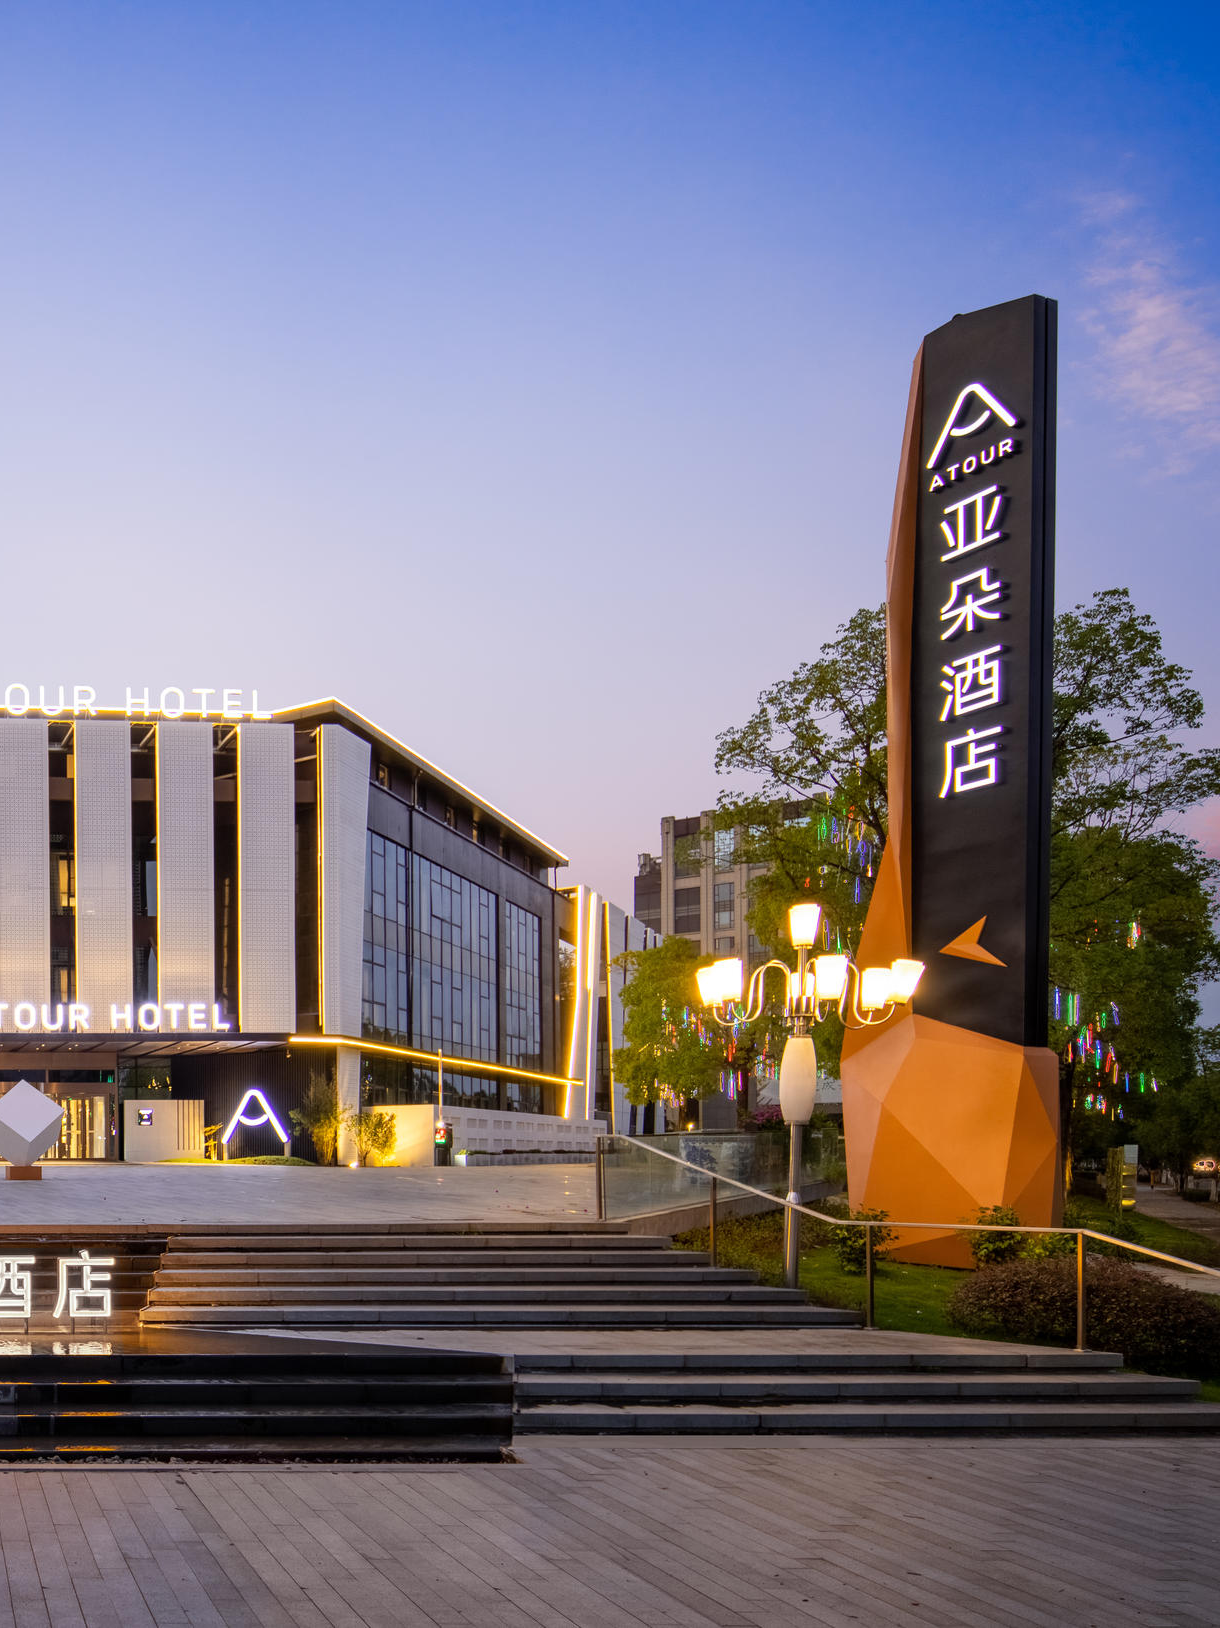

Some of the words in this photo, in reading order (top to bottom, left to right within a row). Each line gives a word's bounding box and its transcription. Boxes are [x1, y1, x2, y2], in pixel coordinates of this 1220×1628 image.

[929, 437, 1014, 492] ATOUR
[939, 484, 1003, 799] 亚朵酒店
[126, 686, 273, 719] HOTEL
[110, 1002, 231, 1031] HOTEL
